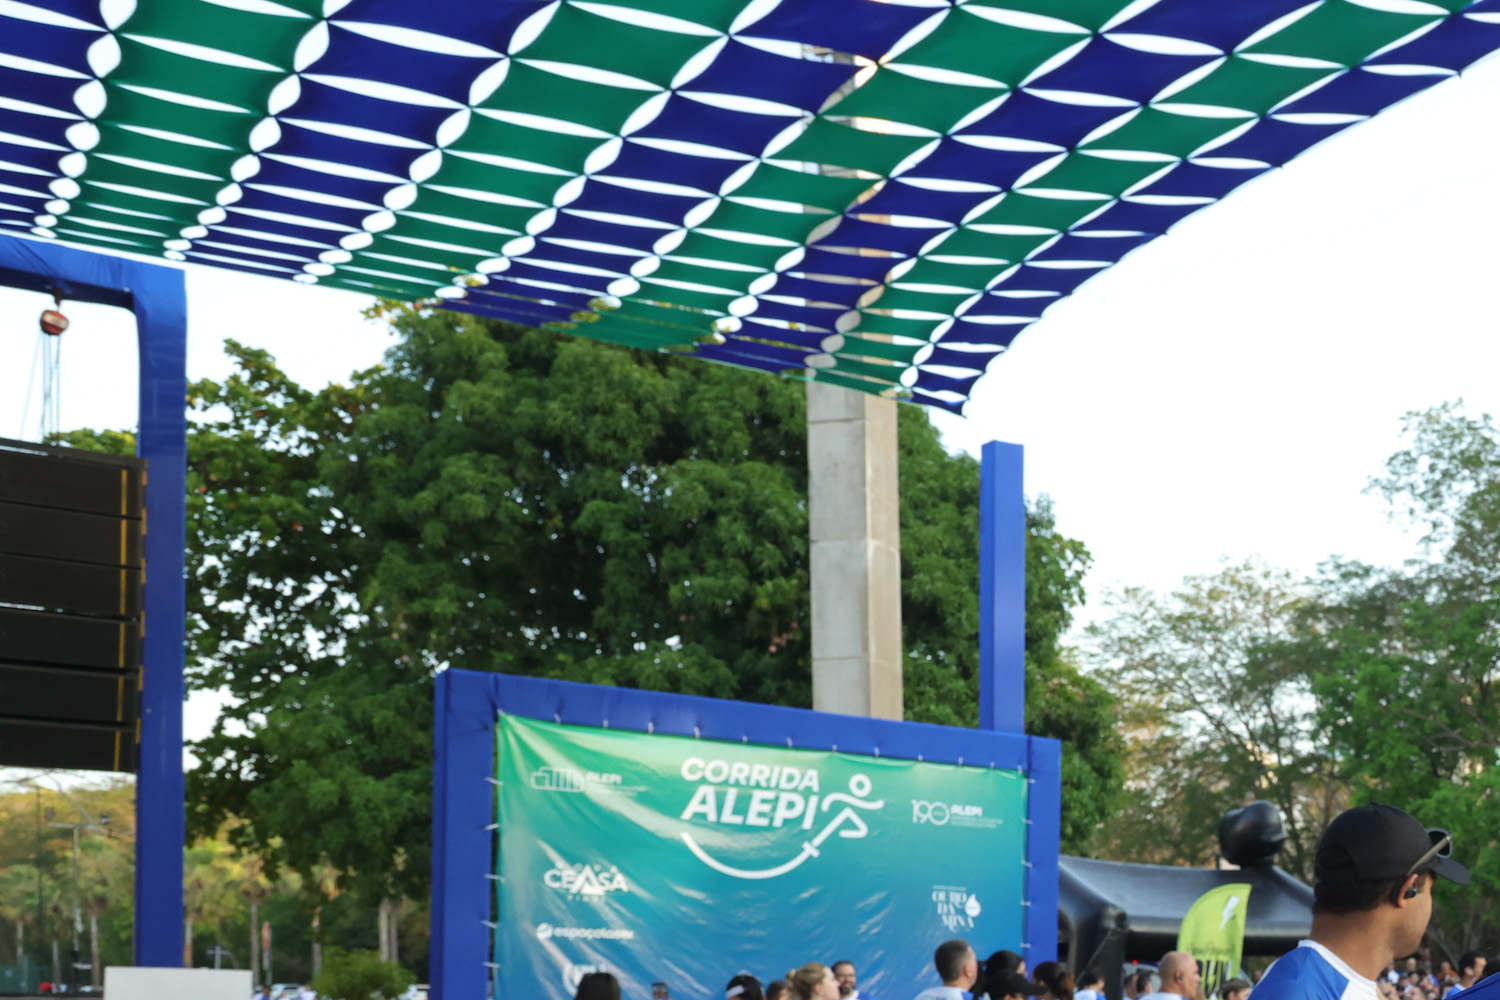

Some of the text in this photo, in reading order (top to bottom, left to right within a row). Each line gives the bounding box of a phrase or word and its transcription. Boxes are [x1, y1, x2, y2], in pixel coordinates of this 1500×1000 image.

[681, 757, 820, 793] CORRIDA
[680, 784, 820, 830] ALEPI
[544, 864, 629, 895] CEASA
